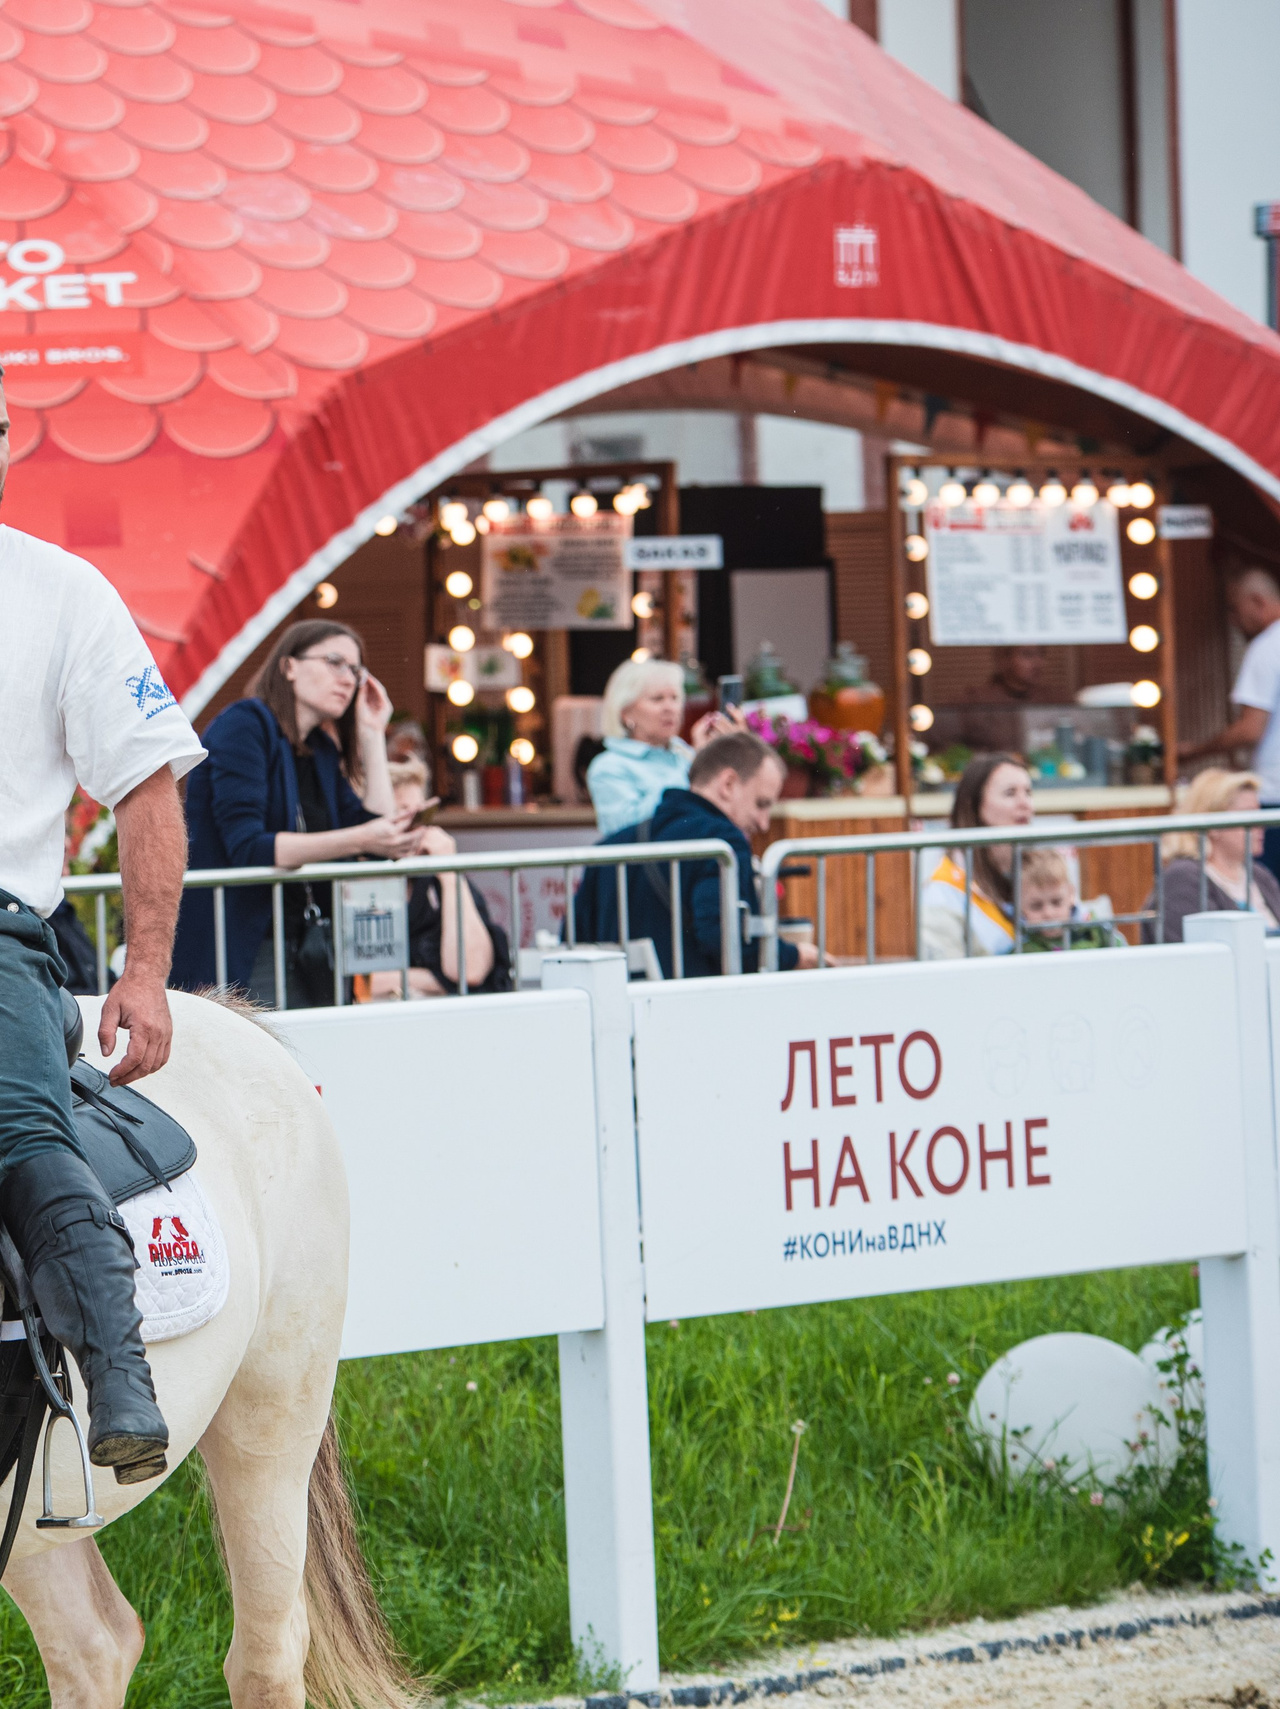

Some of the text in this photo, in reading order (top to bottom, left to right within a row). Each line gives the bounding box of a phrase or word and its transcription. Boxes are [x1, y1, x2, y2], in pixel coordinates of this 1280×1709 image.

[780, 1029, 942, 1112] ЛЕТО
[782, 1117, 1051, 1211] НА КОНЕ
[148, 1241, 200, 1263] DIVOZA
[783, 1219, 948, 1262] #КОНИнаВДНХ
